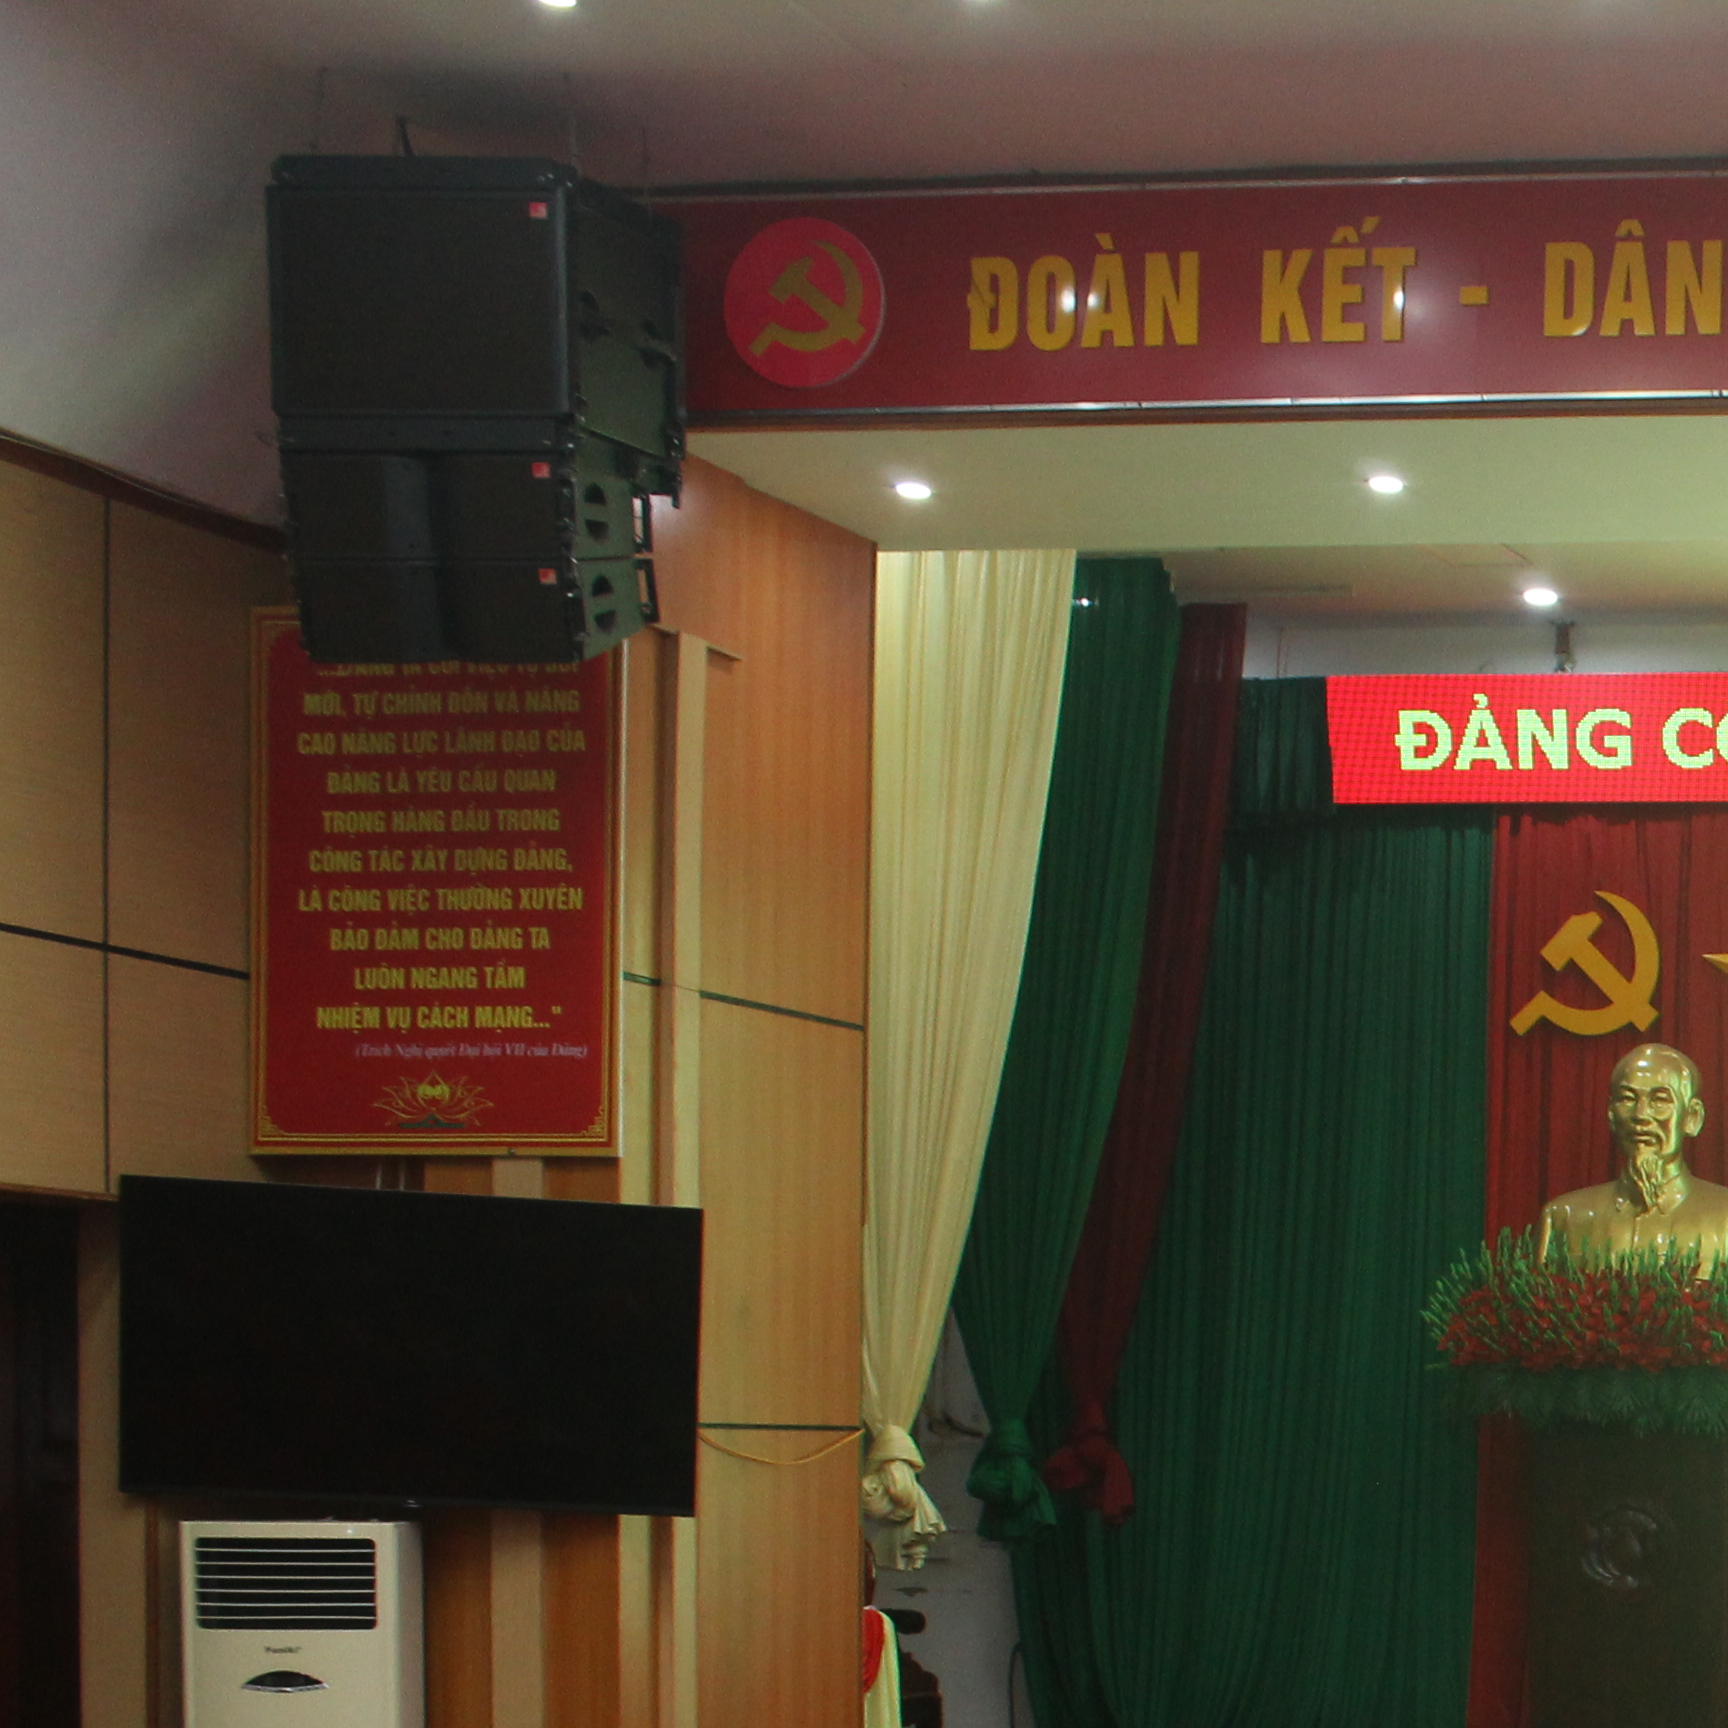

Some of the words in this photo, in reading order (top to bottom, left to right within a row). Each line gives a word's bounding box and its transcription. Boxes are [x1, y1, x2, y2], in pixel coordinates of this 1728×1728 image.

[968, 234, 1199, 351] ĐOÀN
[1261, 218, 1416, 343] KẾT
[1544, 221, 1723, 337] DÂN
[1395, 695, 1632, 770] ĐẢNG
